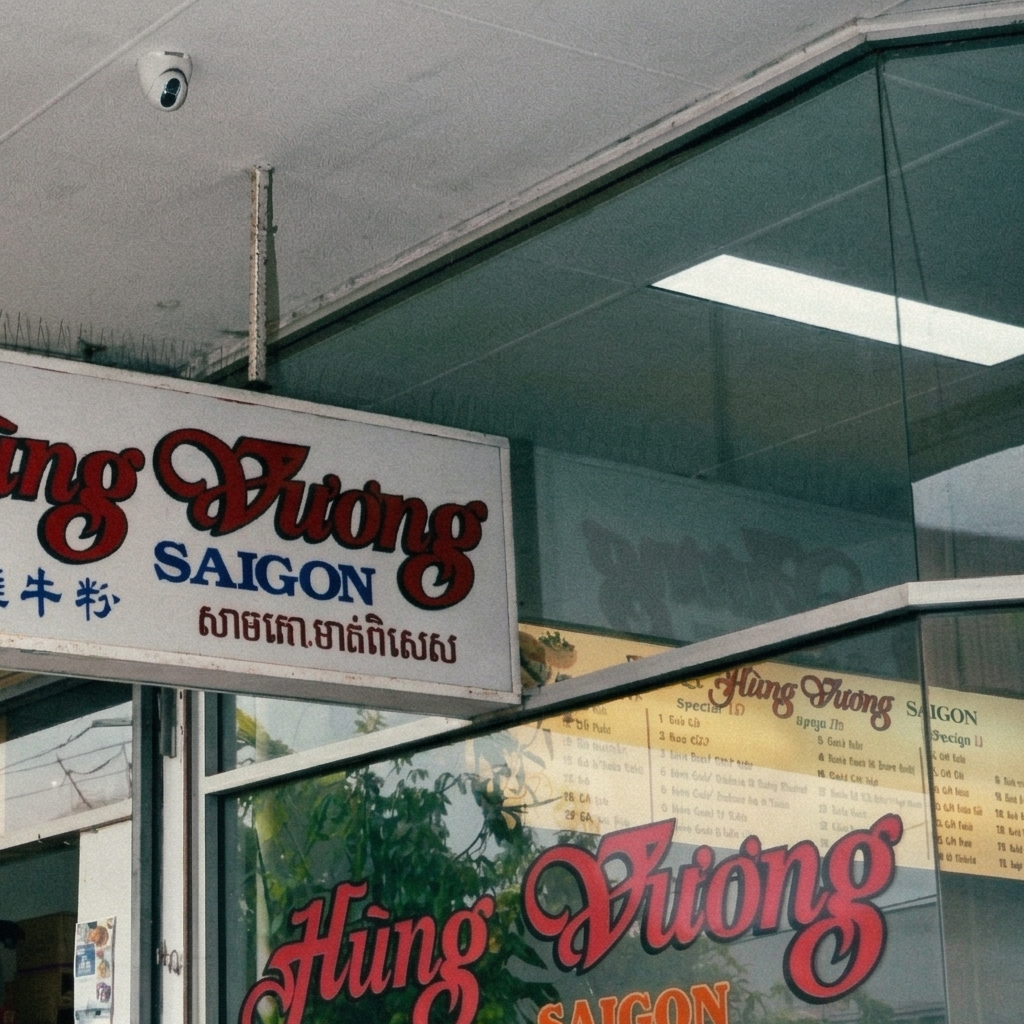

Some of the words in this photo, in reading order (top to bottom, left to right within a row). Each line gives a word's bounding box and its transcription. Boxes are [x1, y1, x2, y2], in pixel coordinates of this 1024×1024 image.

[153, 428, 488, 610] Vương
[154, 540, 375, 605] SAIGON
[521, 813, 904, 1005] Vương
